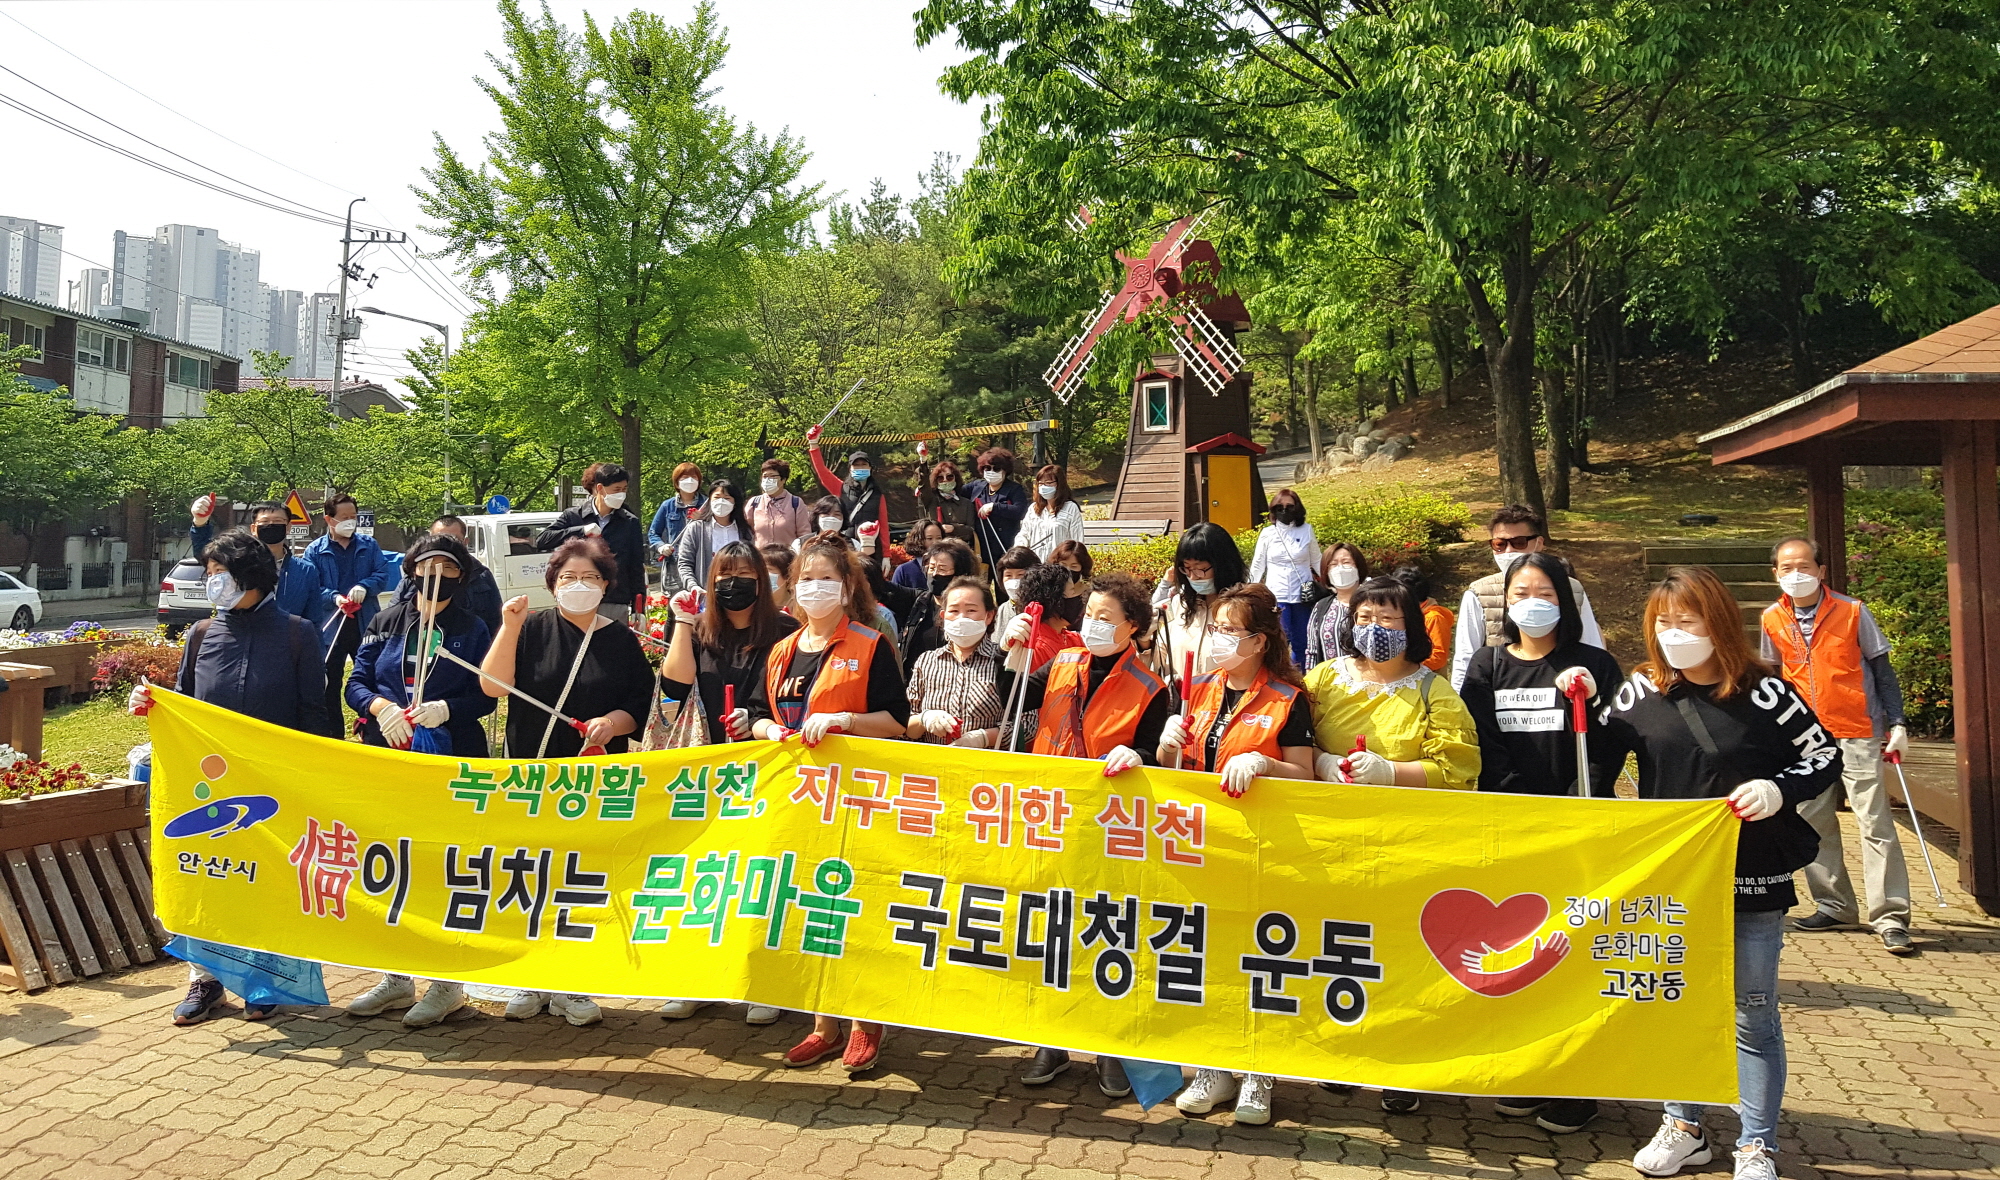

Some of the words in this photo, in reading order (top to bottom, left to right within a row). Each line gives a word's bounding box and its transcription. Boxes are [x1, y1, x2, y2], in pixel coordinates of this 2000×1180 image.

[291, 527, 308, 535] 30m
[1509, 693, 1531, 703] WEAR
[1532, 694, 1547, 703] OUT
[1498, 716, 1518, 726] YOUR
[1520, 715, 1556, 725] WELCOME
[449, 762, 646, 820] 녹색생활
[666, 761, 766, 820] 실천,
[791, 764, 944, 836] 지구를
[967, 783, 1072, 852] 위한
[1097, 795, 1205, 867] 실천
[177, 852, 258, 882] 안산시
[1739, 886, 1753, 895] THE
[1754, 886, 1768, 894] END.
[289, 816, 411, 925] 情이
[442, 845, 610, 941] 넘치는
[631, 851, 862, 958] 문화마을
[887, 871, 1207, 1006] 국토대청결
[1240, 911, 1384, 1026] 운동
[1564, 897, 1609, 927] 정이
[1620, 895, 1688, 925] 넘치는
[1590, 932, 1688, 964] 문화마을
[1600, 969, 1686, 1002] 고잔동
